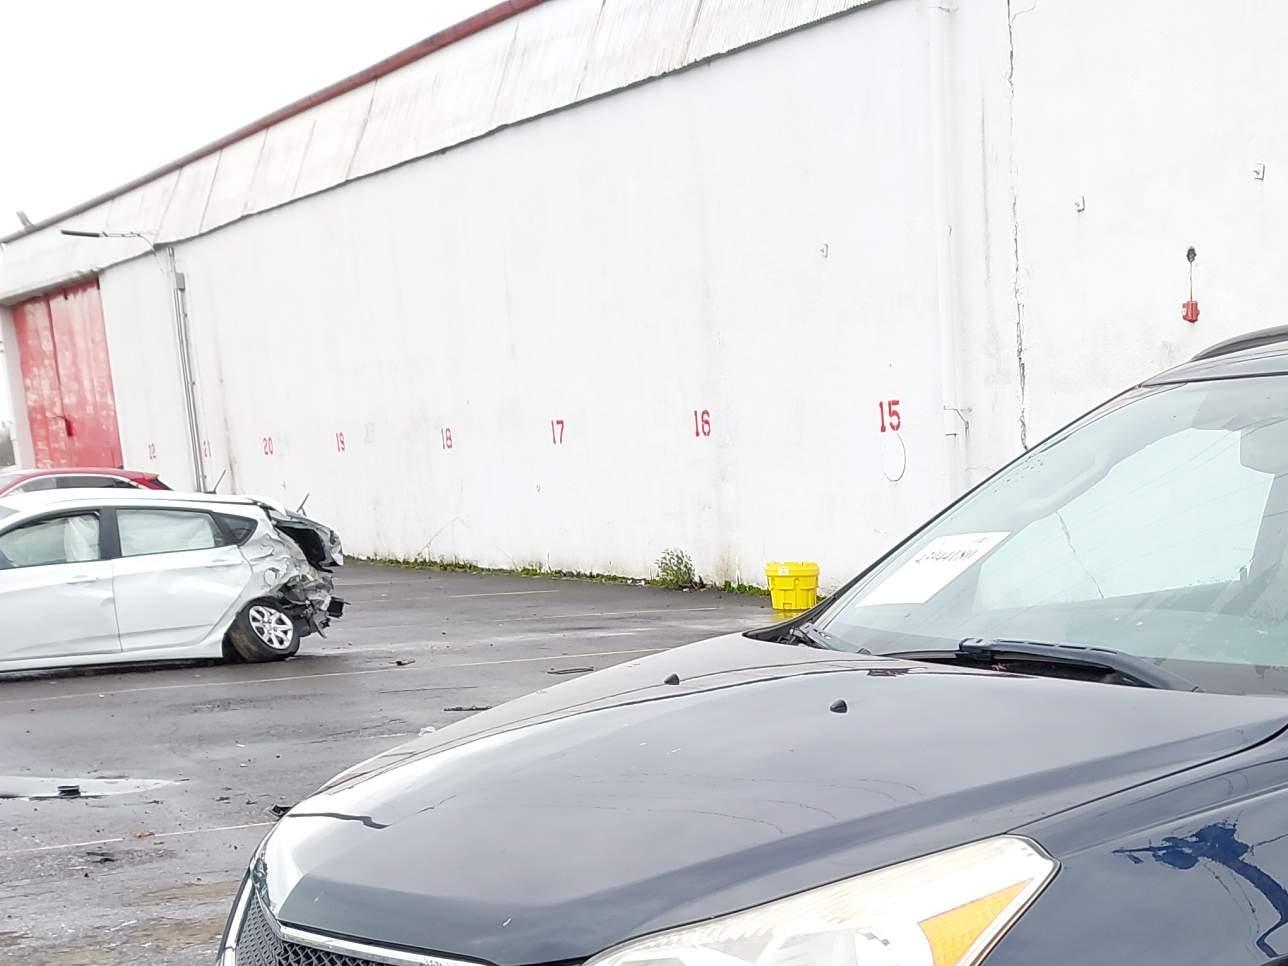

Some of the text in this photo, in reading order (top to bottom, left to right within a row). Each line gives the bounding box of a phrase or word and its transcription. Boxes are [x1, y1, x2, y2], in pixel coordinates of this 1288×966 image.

[693, 409, 711, 438] 16
[878, 400, 901, 433] 15
[335, 431, 345, 452] 19
[440, 427, 453, 450] 18
[551, 420, 565, 445] 17
[262, 436, 274, 456] 20
